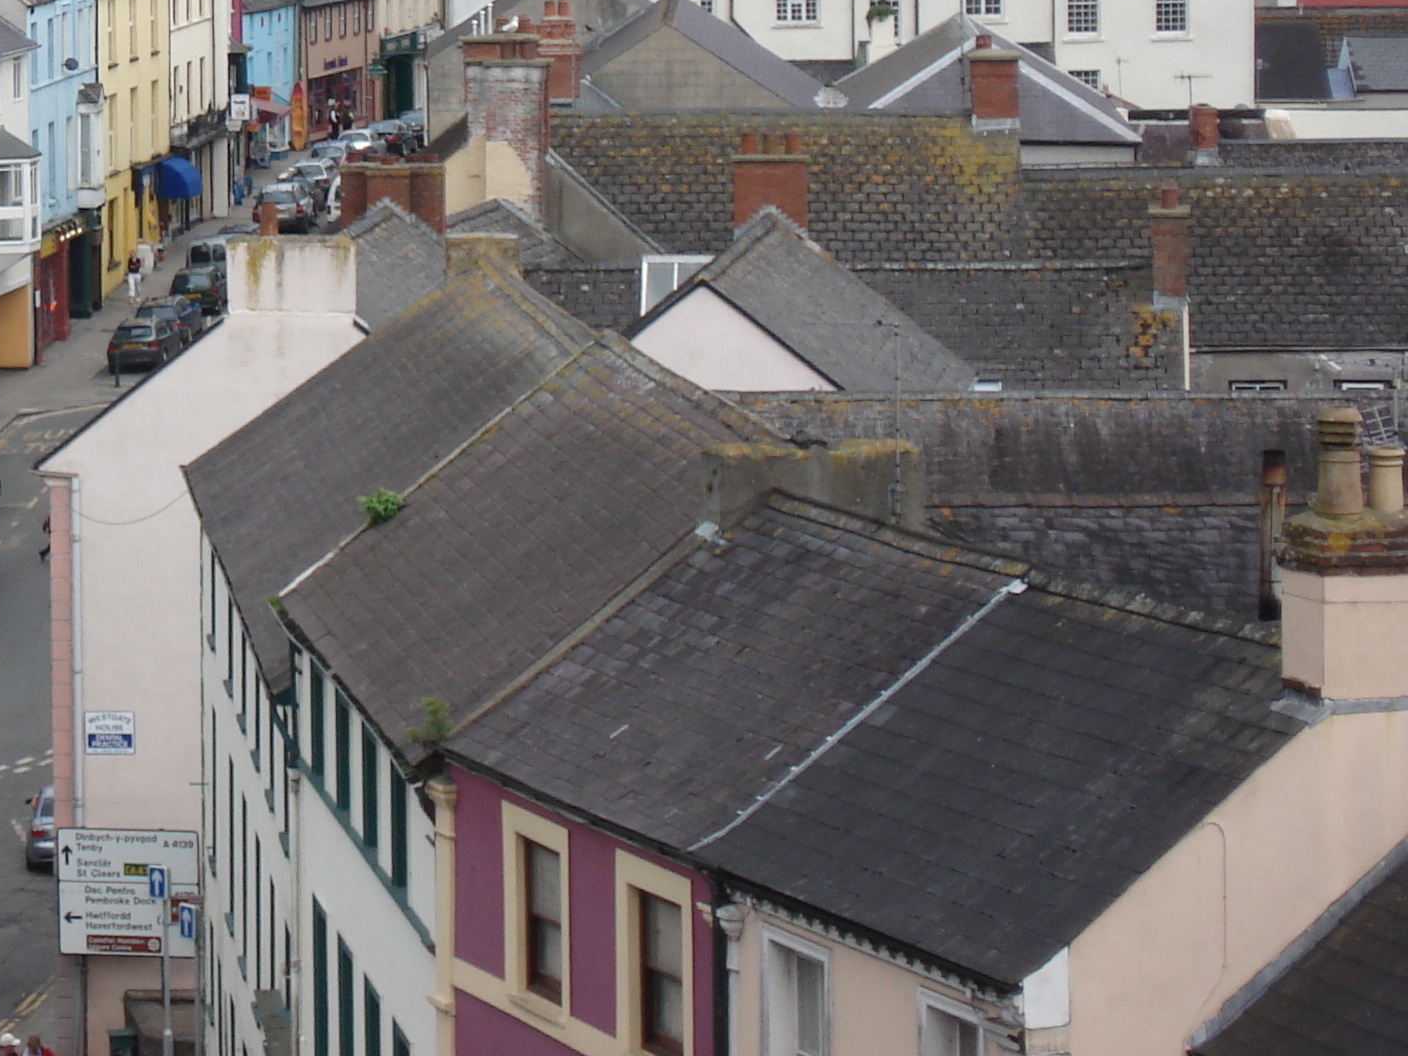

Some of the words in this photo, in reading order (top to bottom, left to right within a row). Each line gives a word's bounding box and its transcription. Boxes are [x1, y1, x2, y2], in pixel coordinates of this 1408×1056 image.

[87, 713, 132, 725] WESTGATE
[75, 833, 157, 844] Dinbych-y-pysgod
[76, 843, 103, 853] Tenby
[163, 840, 170, 848] A
[171, 841, 194, 849] 4139
[77, 869, 87, 877] St
[91, 869, 121, 878] Clears
[84, 886, 102, 895] Doc
[106, 886, 136, 895] Penfro
[85, 896, 131, 905] Pembroke
[133, 897, 157, 905] Dock
[85, 923, 153, 931] Haverfordwest
